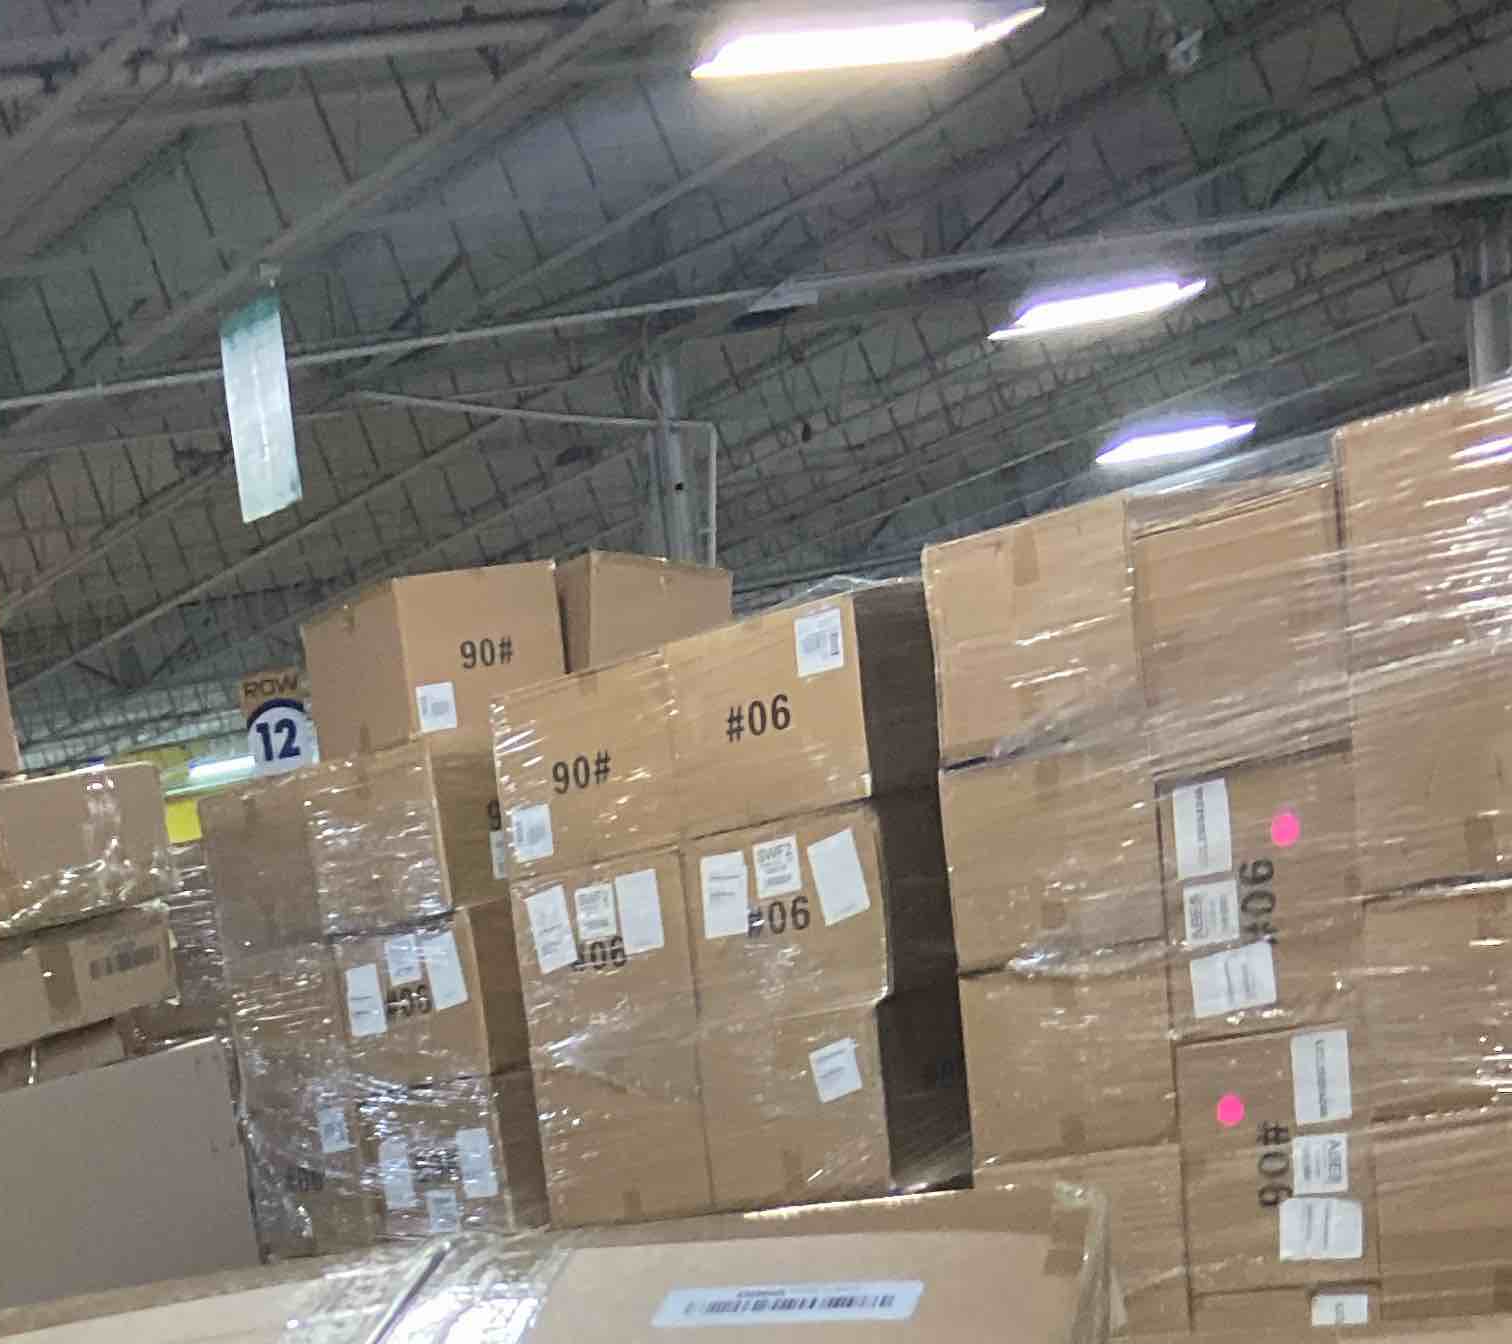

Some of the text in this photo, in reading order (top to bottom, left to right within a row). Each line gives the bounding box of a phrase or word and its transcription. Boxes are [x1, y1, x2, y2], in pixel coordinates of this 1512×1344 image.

[459, 635, 513, 669] 90#
[243, 672, 299, 697] ROW
[255, 717, 301, 762] 12
